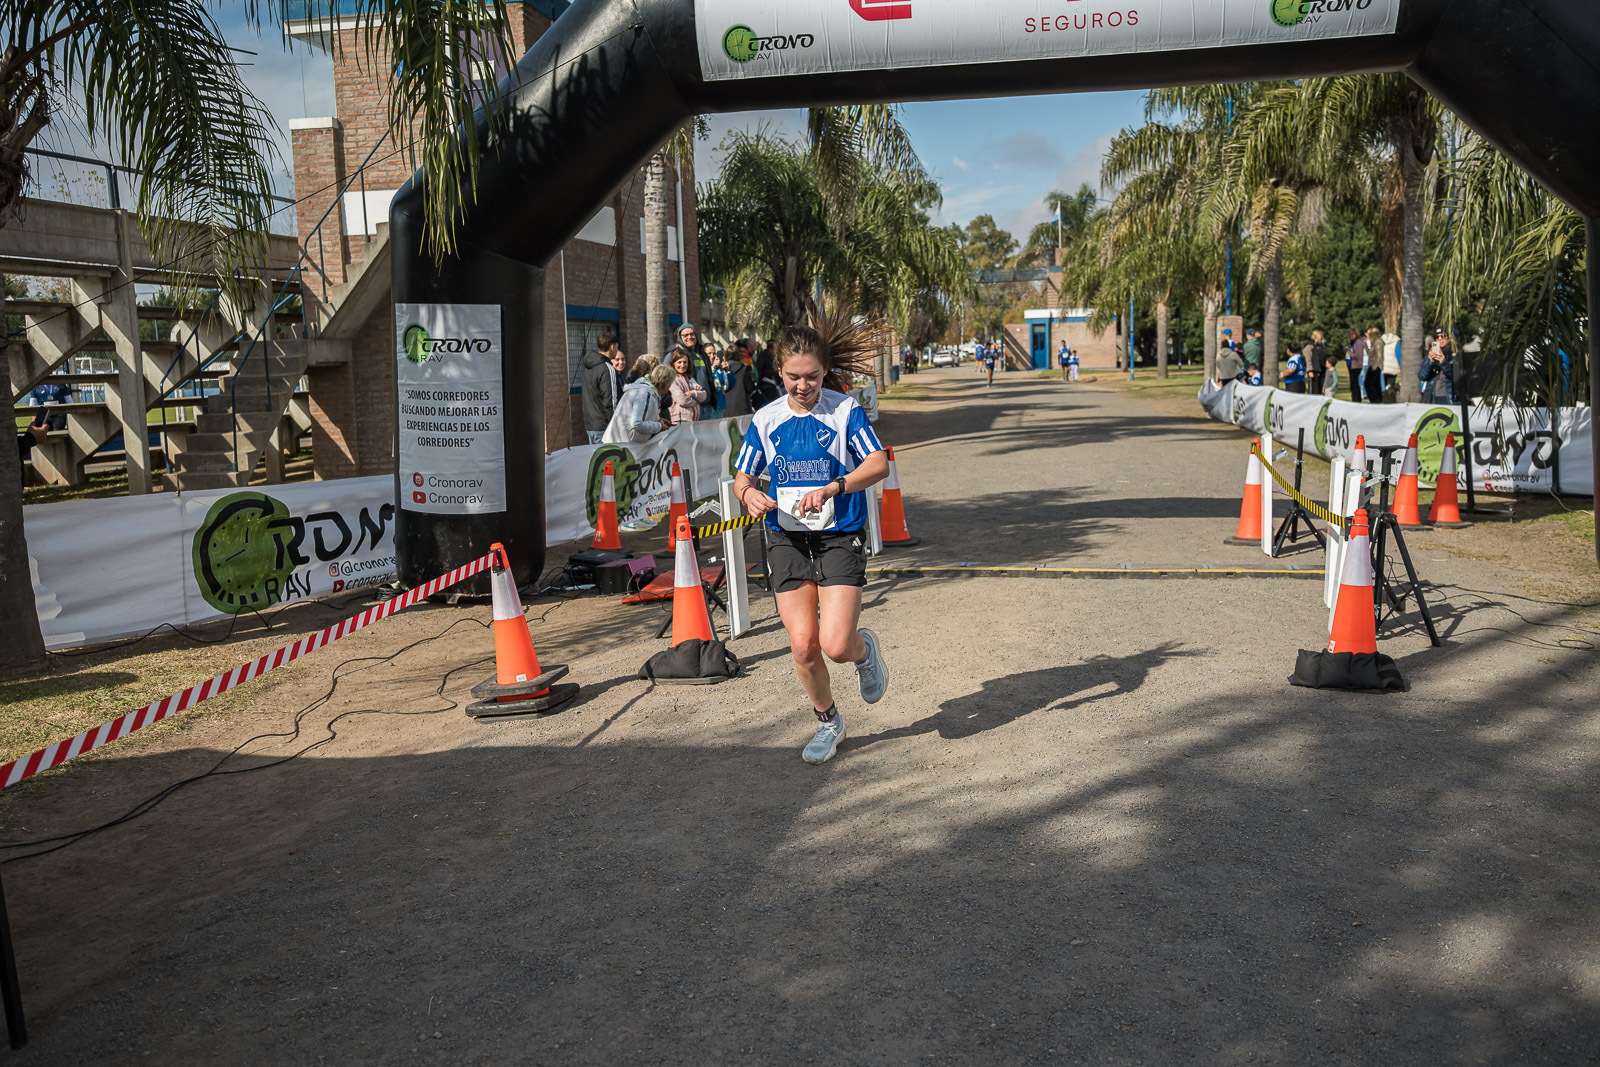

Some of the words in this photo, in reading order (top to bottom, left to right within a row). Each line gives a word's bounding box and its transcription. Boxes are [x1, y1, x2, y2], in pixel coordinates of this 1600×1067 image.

[1025, 10, 1139, 33] SEGUROS
[1295, 15, 1322, 24] RAV
[748, 33, 814, 51] CRONO
[748, 52, 771, 61] RAV
[422, 338, 491, 353] CRONO
[421, 354, 443, 363] RAV
[432, 391, 490, 401] CORREDORES
[401, 404, 436, 416] BUSCANDO
[438, 406, 480, 417] MEJORAR
[481, 406, 498, 416] LAS
[406, 420, 458, 432] EXPERIENCIAS
[460, 422, 472, 432] DE
[473, 422, 490, 431] LOS
[417, 436, 475, 447] CORREDORES”
[428, 476, 483, 488] Cronorav
[429, 492, 484, 504] Cronorav
[341, 556, 396, 576] @cronora
[264, 570, 312, 605] RAV
